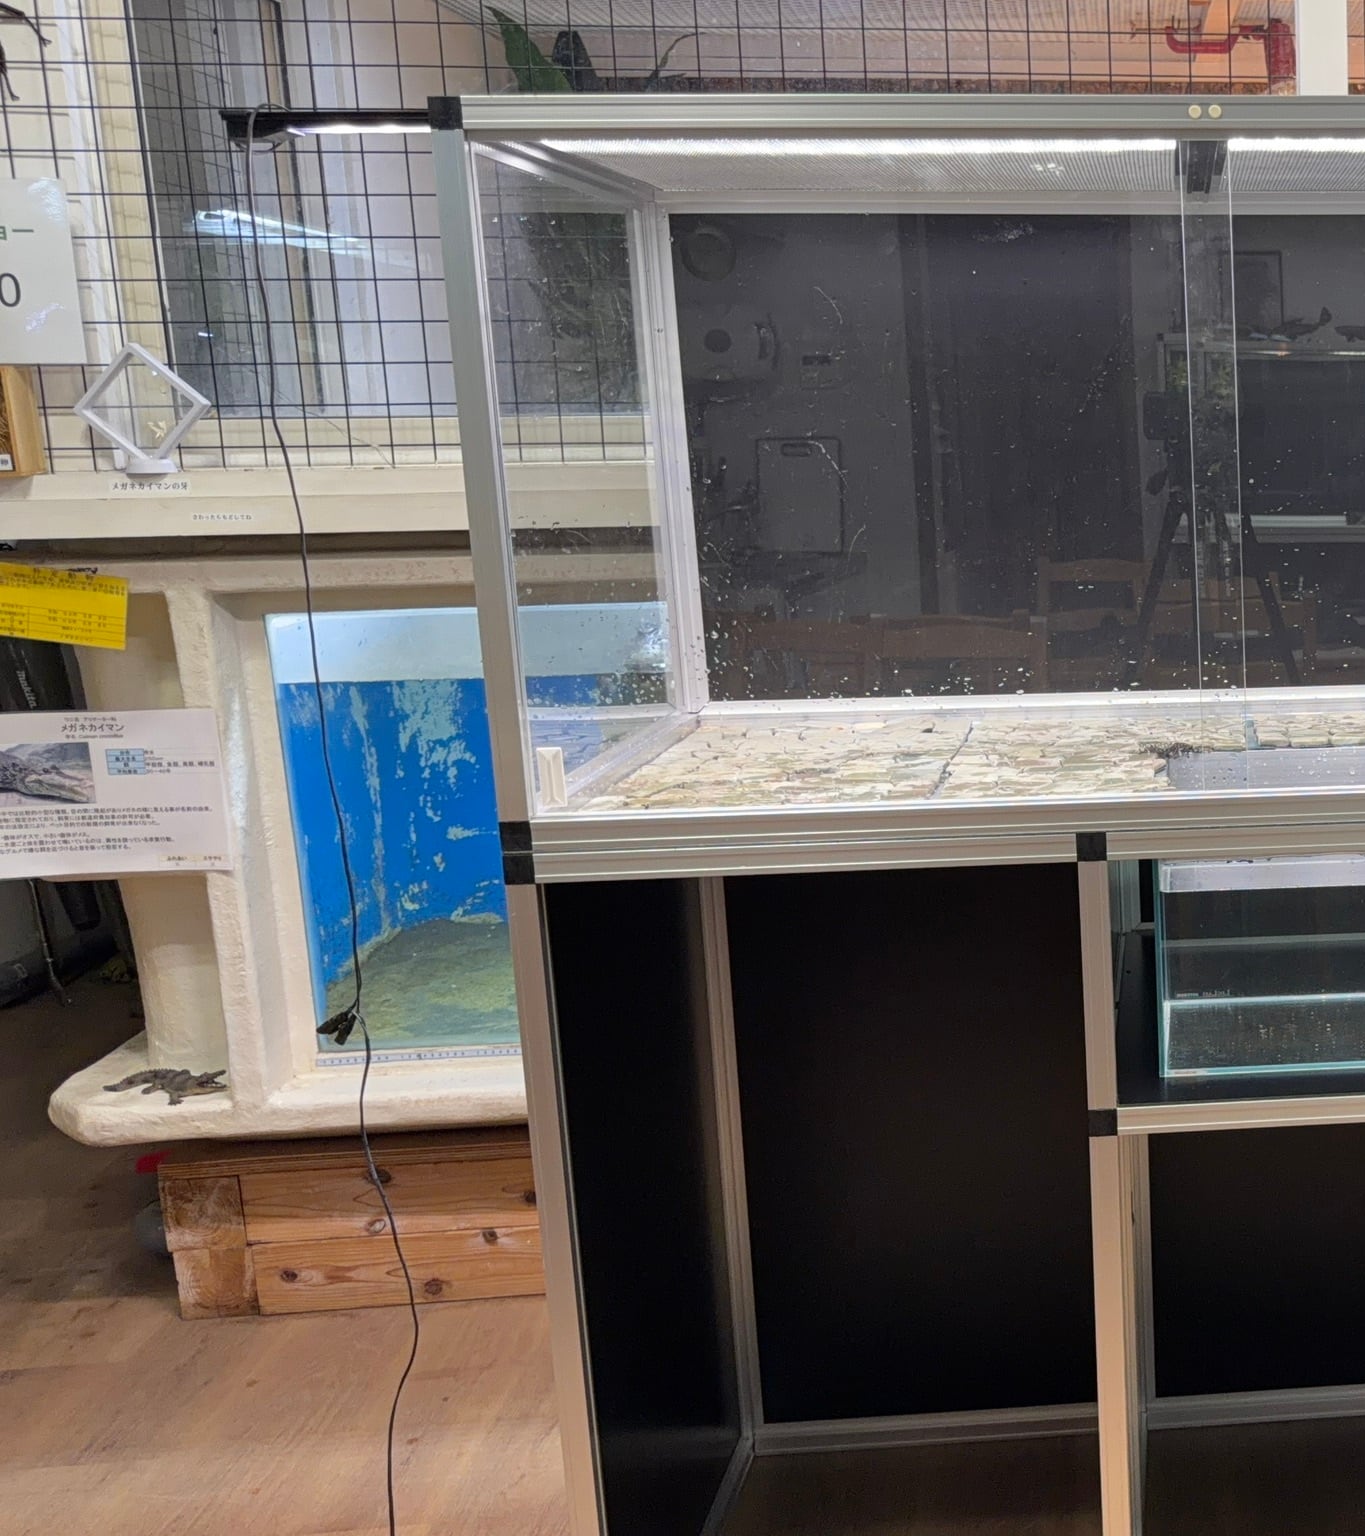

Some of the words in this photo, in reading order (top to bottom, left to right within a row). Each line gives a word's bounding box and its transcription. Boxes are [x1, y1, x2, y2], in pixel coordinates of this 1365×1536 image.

[112, 482, 188, 491] メガネカイマンの牙
[16, 670, 37, 709] makita
[61, 723, 124, 734] メガネカイマン
